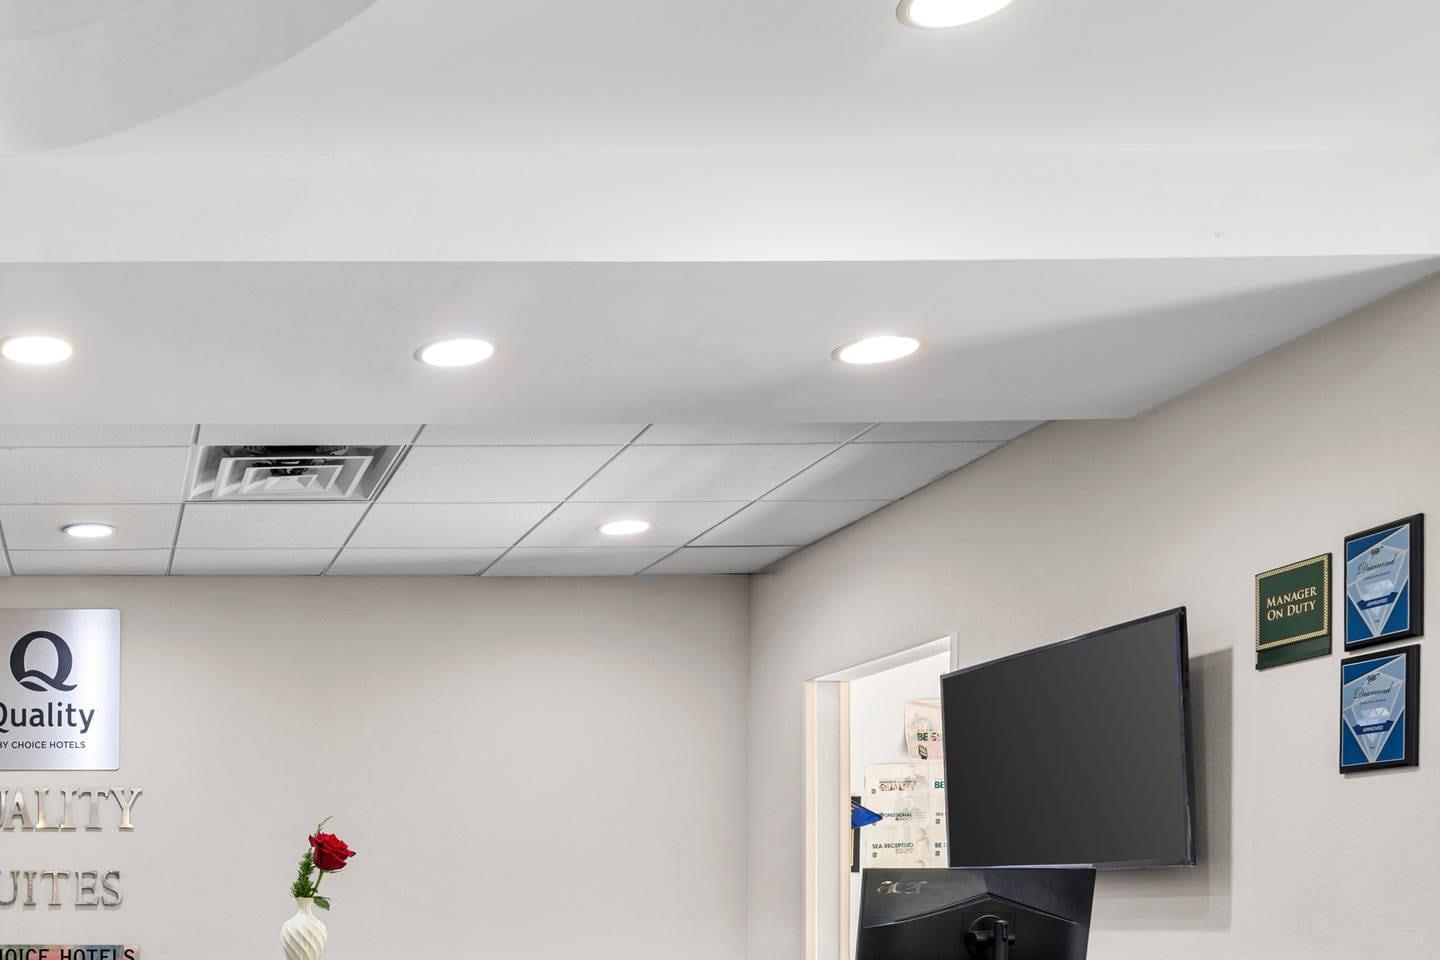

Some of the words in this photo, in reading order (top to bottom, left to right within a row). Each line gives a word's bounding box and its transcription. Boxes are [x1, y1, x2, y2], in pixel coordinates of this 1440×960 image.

[1265, 586, 1317, 608] MANAGER
[1267, 608, 1283, 621] ON
[1287, 600, 1316, 617] DUTY
[10, 630, 78, 692] Q
[11, 741, 47, 749] CHOICE
[49, 741, 86, 749] HOTELS
[917, 732, 928, 741] BE
[877, 880, 927, 894] acer
